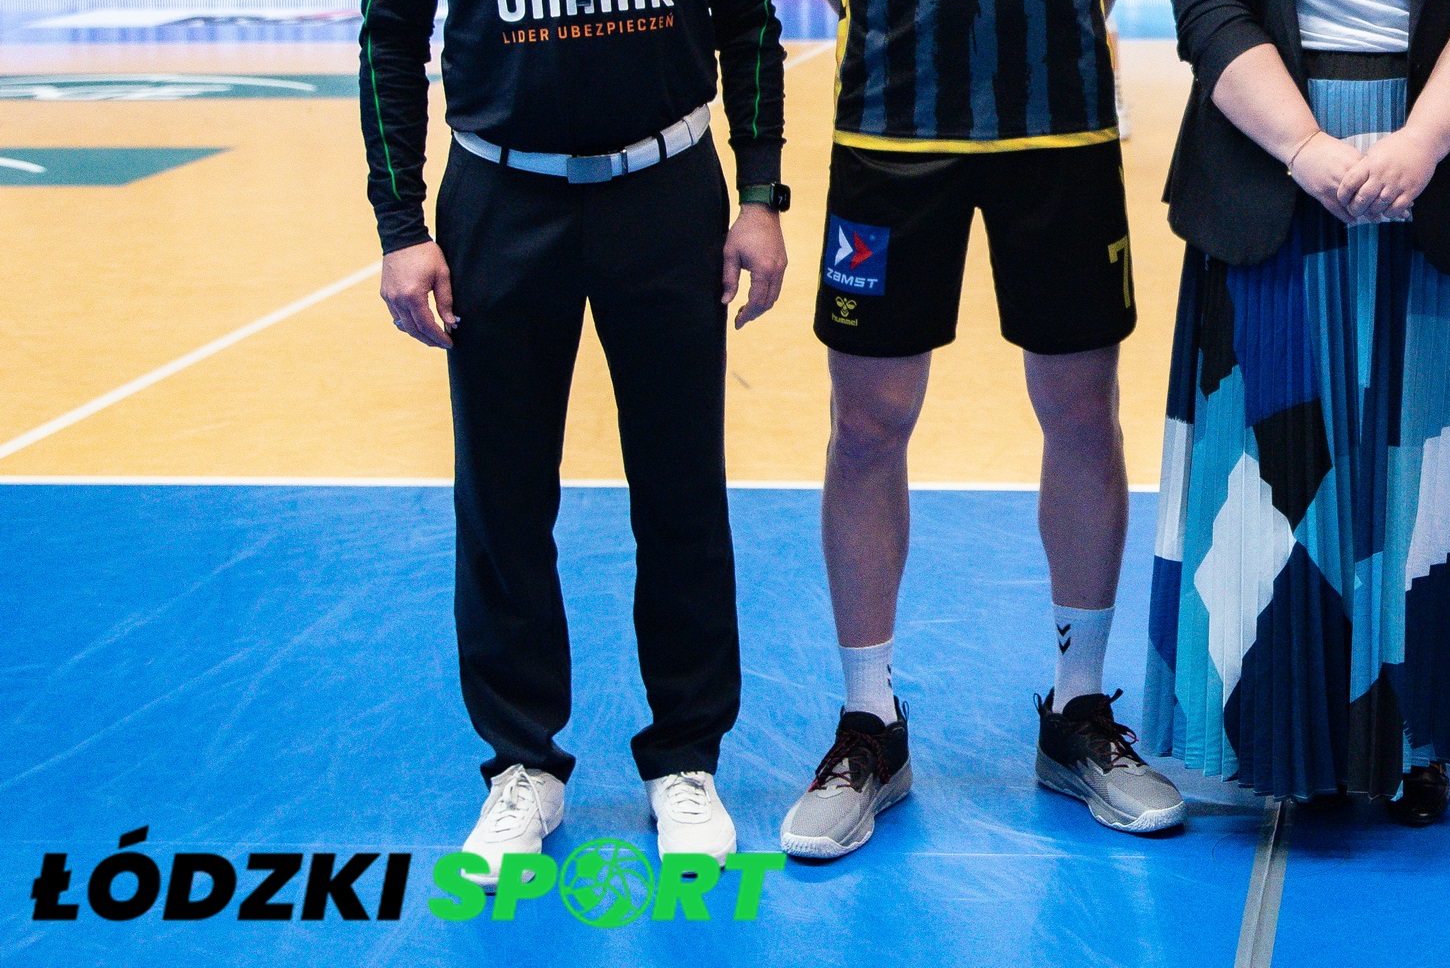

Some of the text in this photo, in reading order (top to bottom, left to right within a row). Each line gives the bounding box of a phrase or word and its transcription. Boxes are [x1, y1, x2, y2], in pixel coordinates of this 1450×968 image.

[503, 12, 675, 44] LIDER UBEZPIECZEŃ
[1107, 235, 1131, 309] 7
